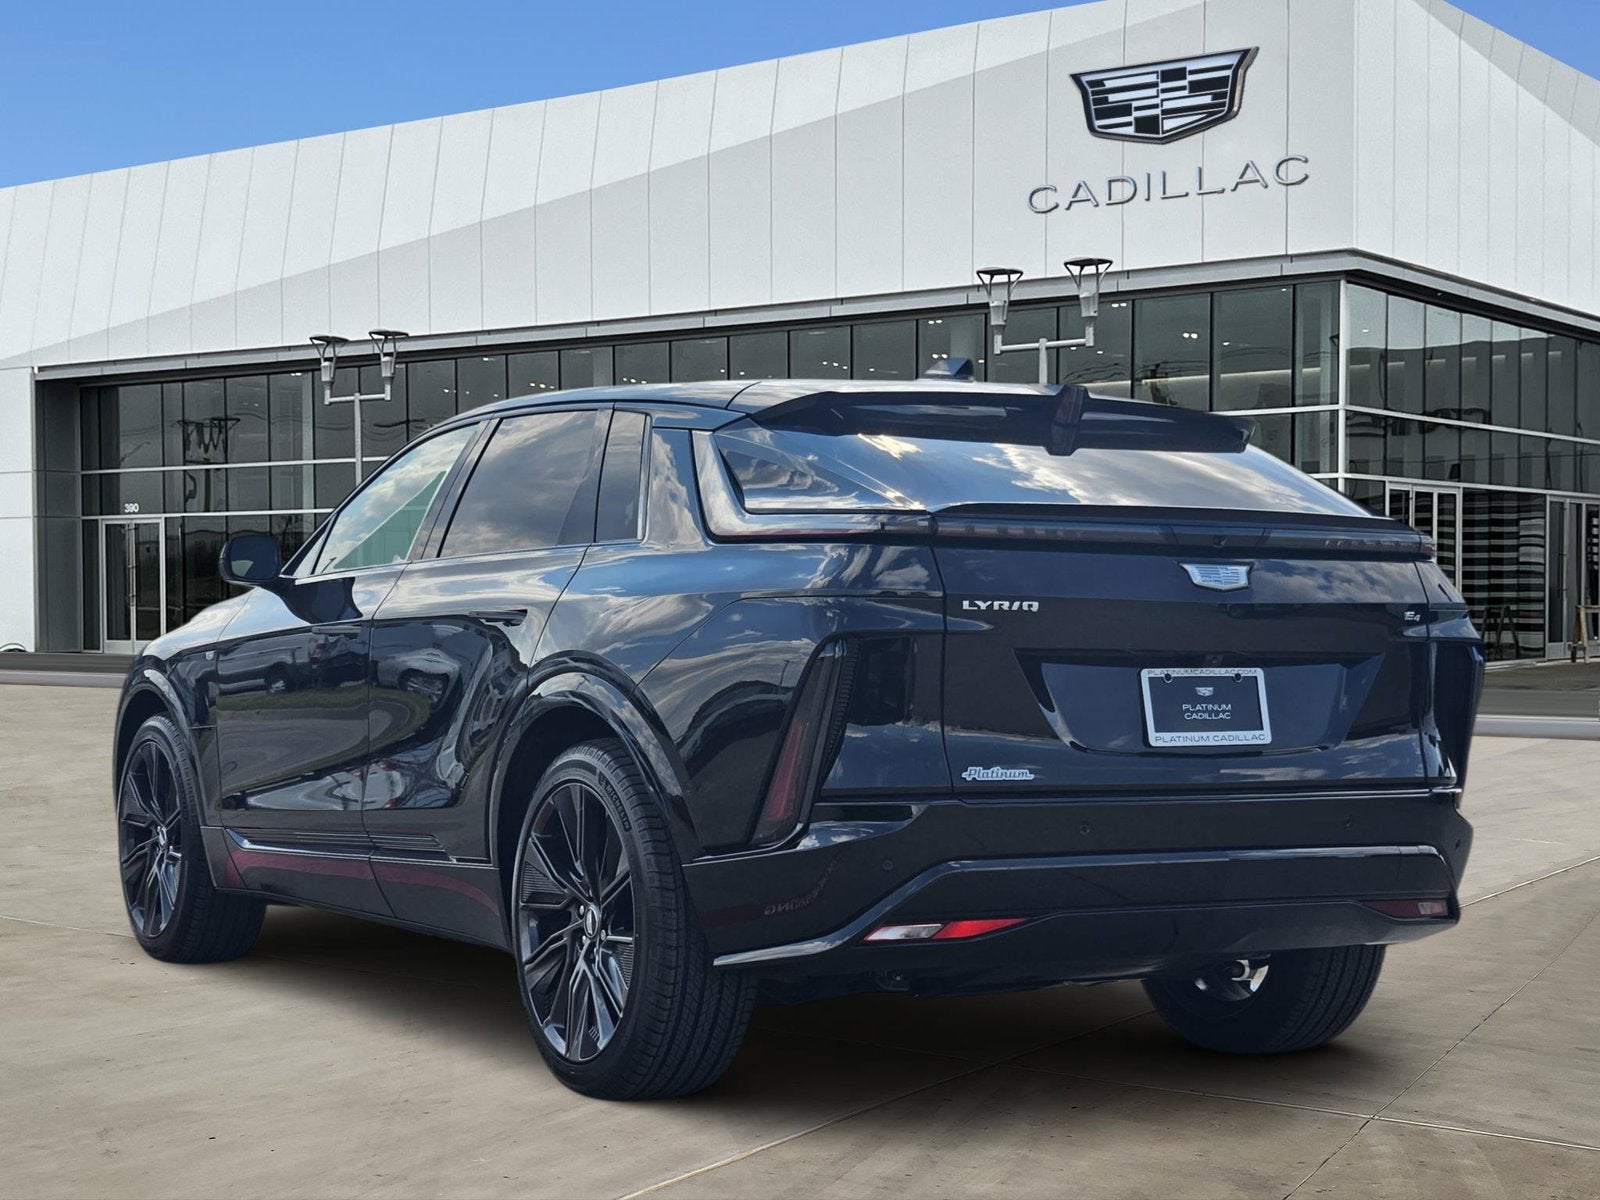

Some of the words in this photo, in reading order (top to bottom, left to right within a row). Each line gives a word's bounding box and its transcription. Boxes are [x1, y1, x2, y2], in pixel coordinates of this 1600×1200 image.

[1028, 155, 1309, 214] CADILLAC
[124, 503, 139, 513] 390
[963, 600, 1039, 612] LYRIQ
[1182, 703, 1232, 711] PLATINUM
[1184, 712, 1231, 720] CADILLAC
[1155, 735, 1210, 743] PLATINUM
[1212, 734, 1266, 742] CADILLAC
[962, 767, 1034, 780] Platinum
